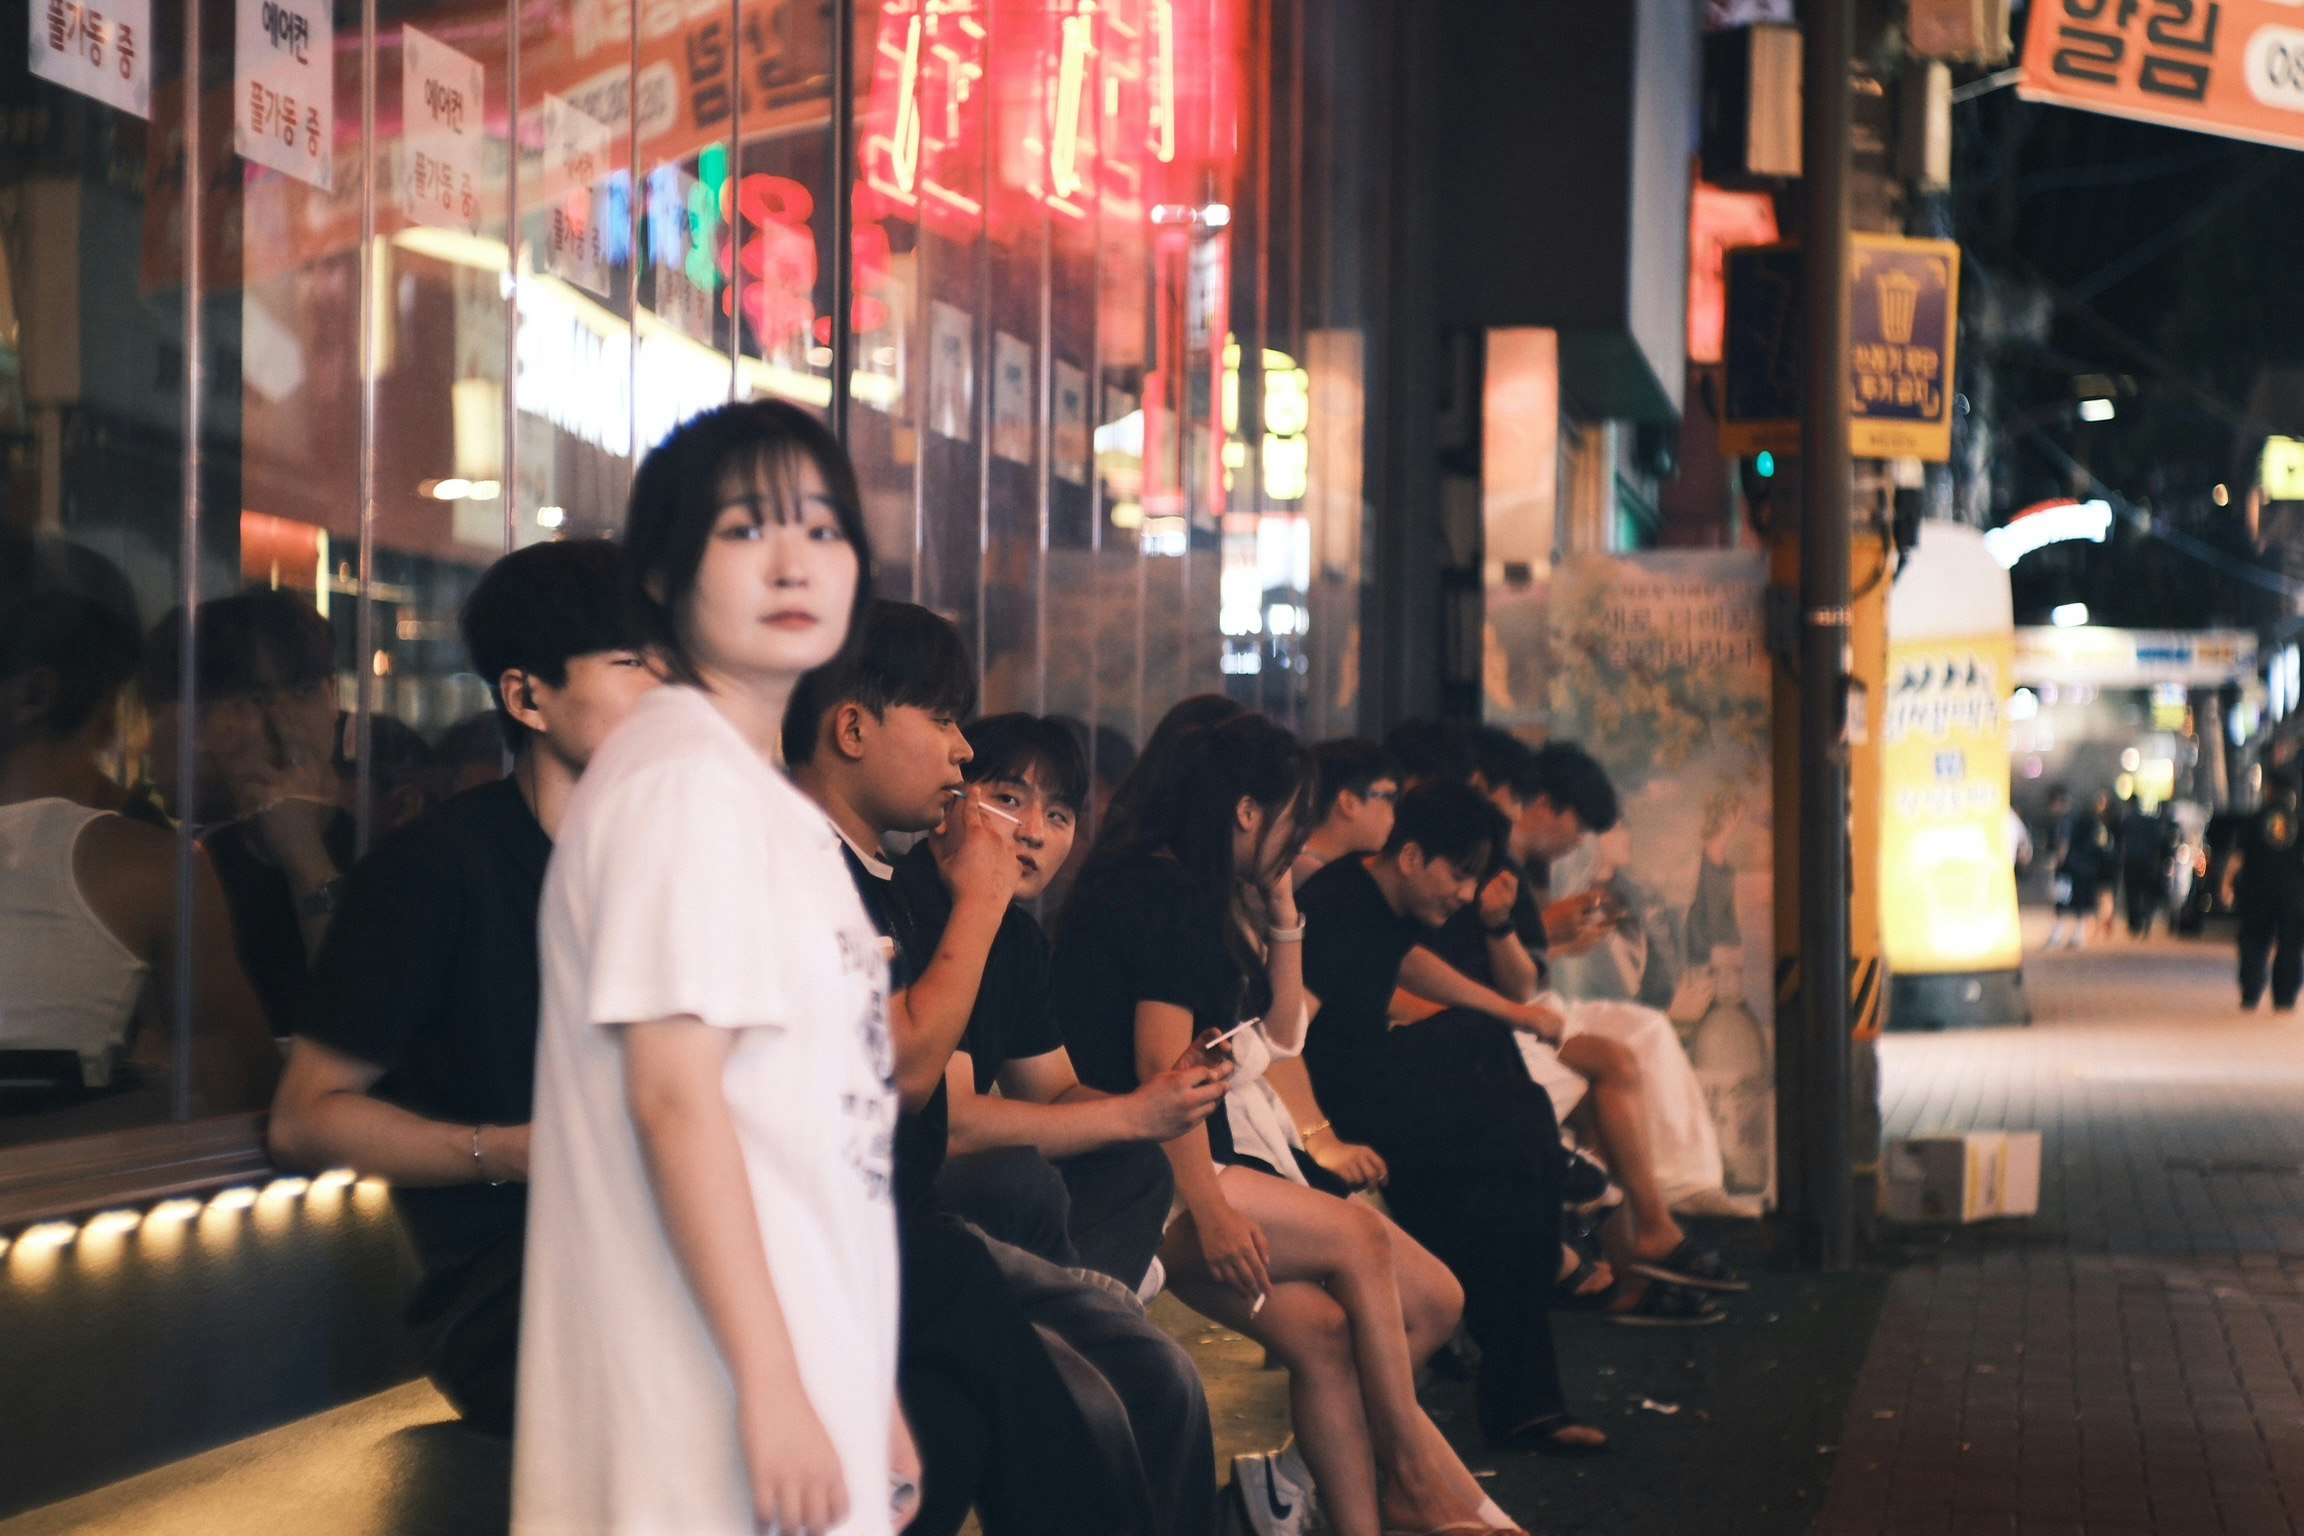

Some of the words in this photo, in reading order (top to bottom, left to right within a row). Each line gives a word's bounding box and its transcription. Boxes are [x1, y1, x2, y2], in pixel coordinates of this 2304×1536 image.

[261, 0, 310, 66] 에어컨
[250, 79, 298, 148] 풀가동
[305, 105, 321, 158] 중
[423, 76, 464, 135] 에어컨
[413, 150, 454, 211] 풀가동
